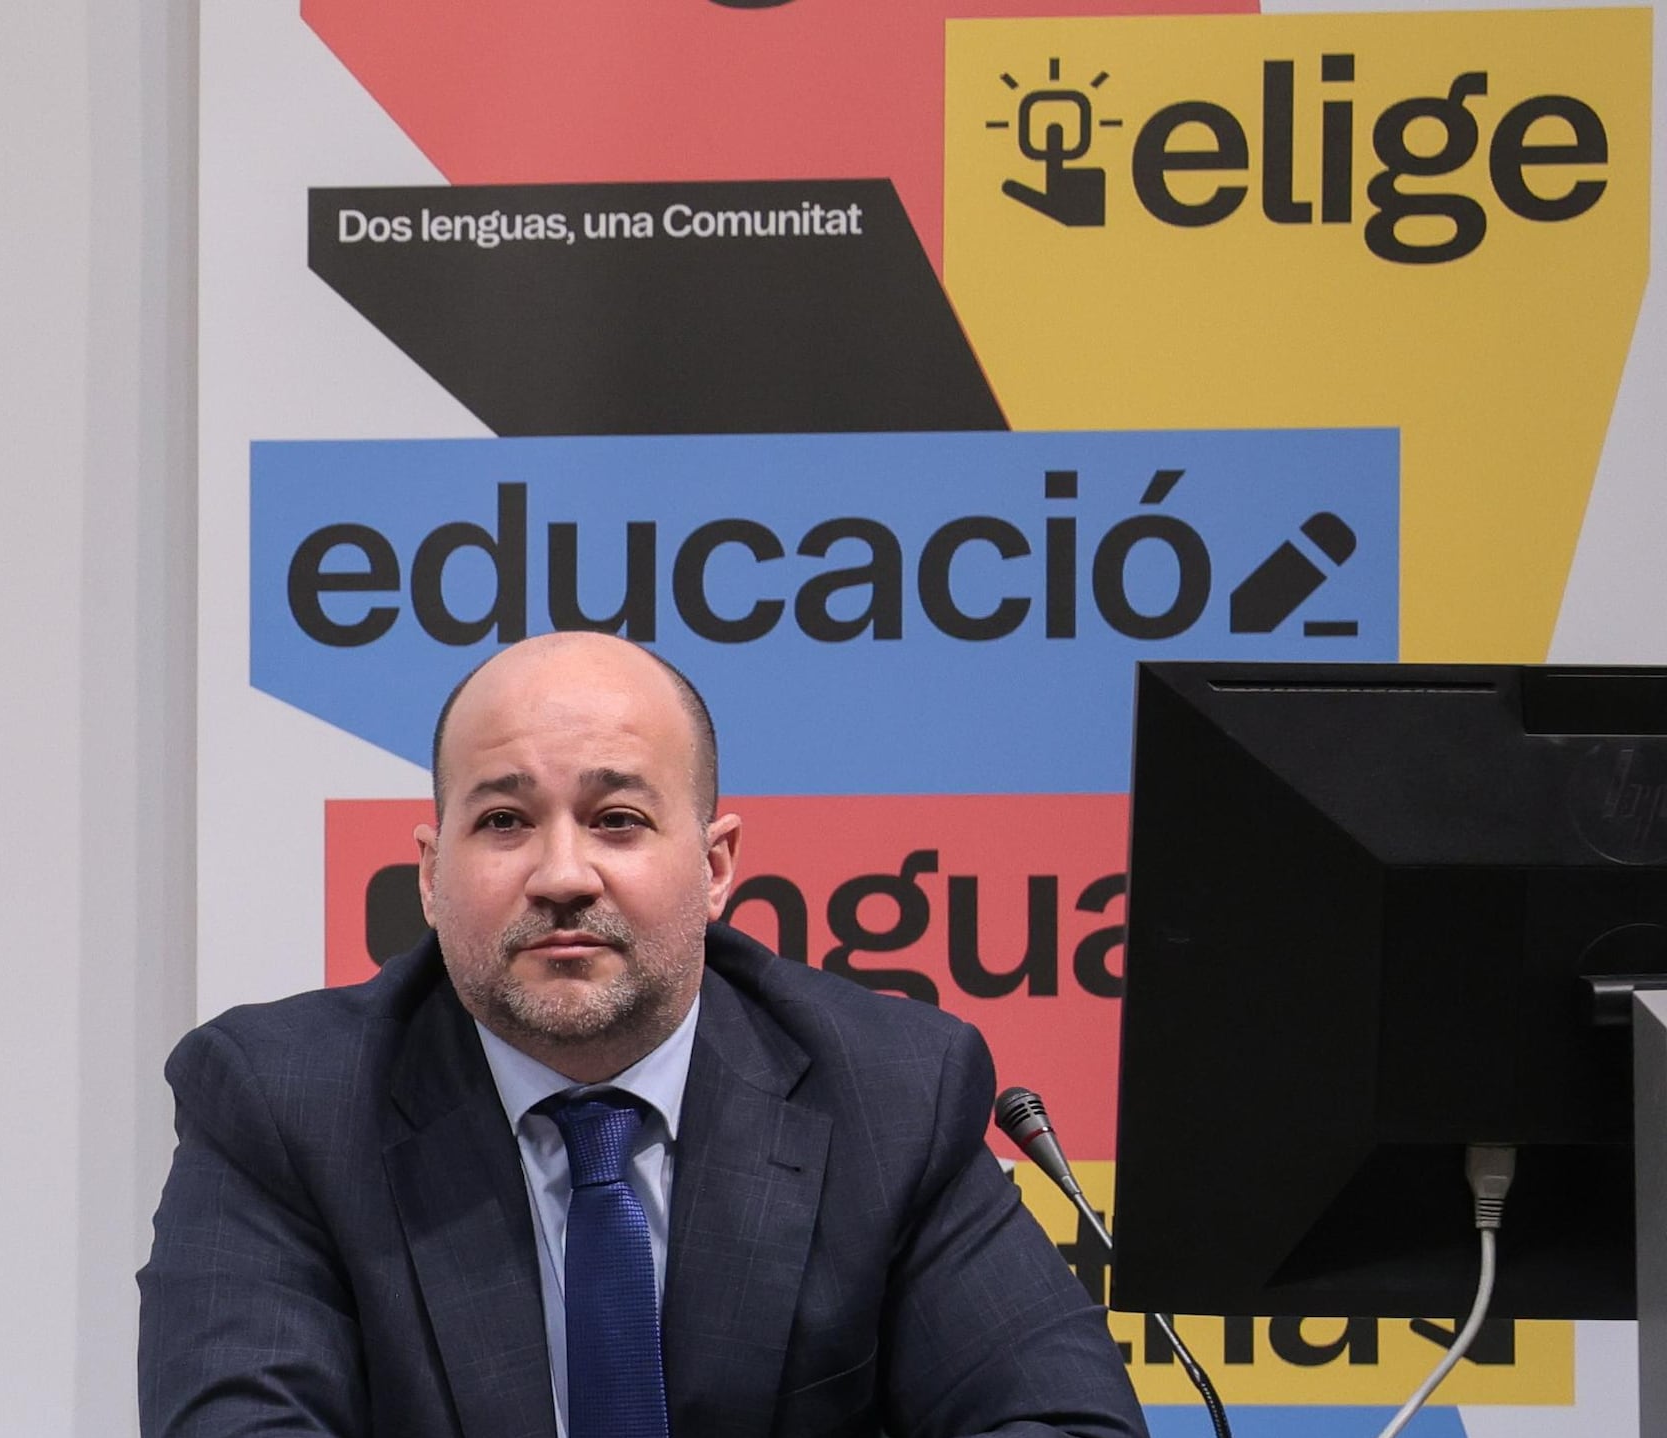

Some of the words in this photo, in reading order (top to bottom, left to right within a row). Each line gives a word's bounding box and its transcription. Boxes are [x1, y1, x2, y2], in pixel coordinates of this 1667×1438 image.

[338, 209, 413, 243] Dos
[421, 208, 576, 249] lenguas,
[584, 212, 654, 239] una
[662, 202, 863, 239] Comunitat
[1132, 53, 1610, 266] elige
[286, 468, 1213, 649] educació
